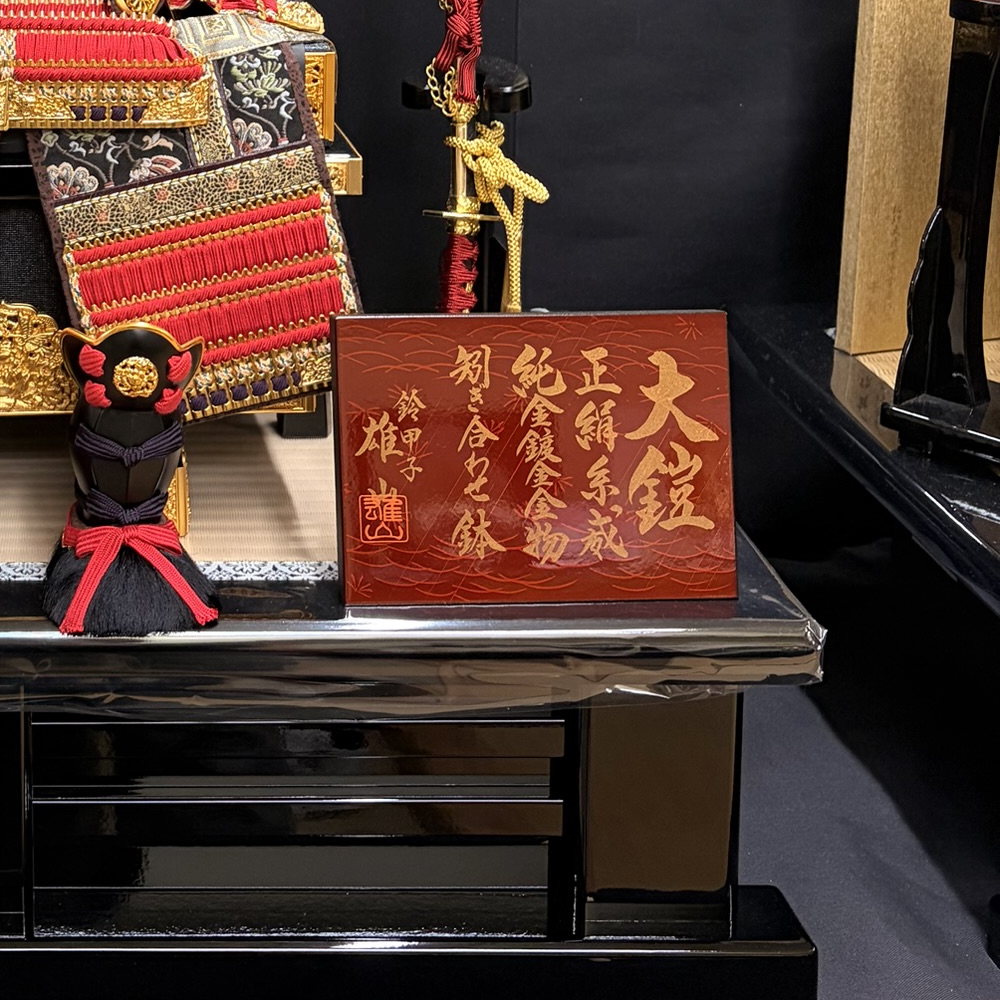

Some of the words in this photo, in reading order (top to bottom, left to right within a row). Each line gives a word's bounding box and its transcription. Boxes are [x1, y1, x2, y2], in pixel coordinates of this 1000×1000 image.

[392, 388, 427, 482] 鈴甲子
[624, 350, 720, 535] 大鎧
